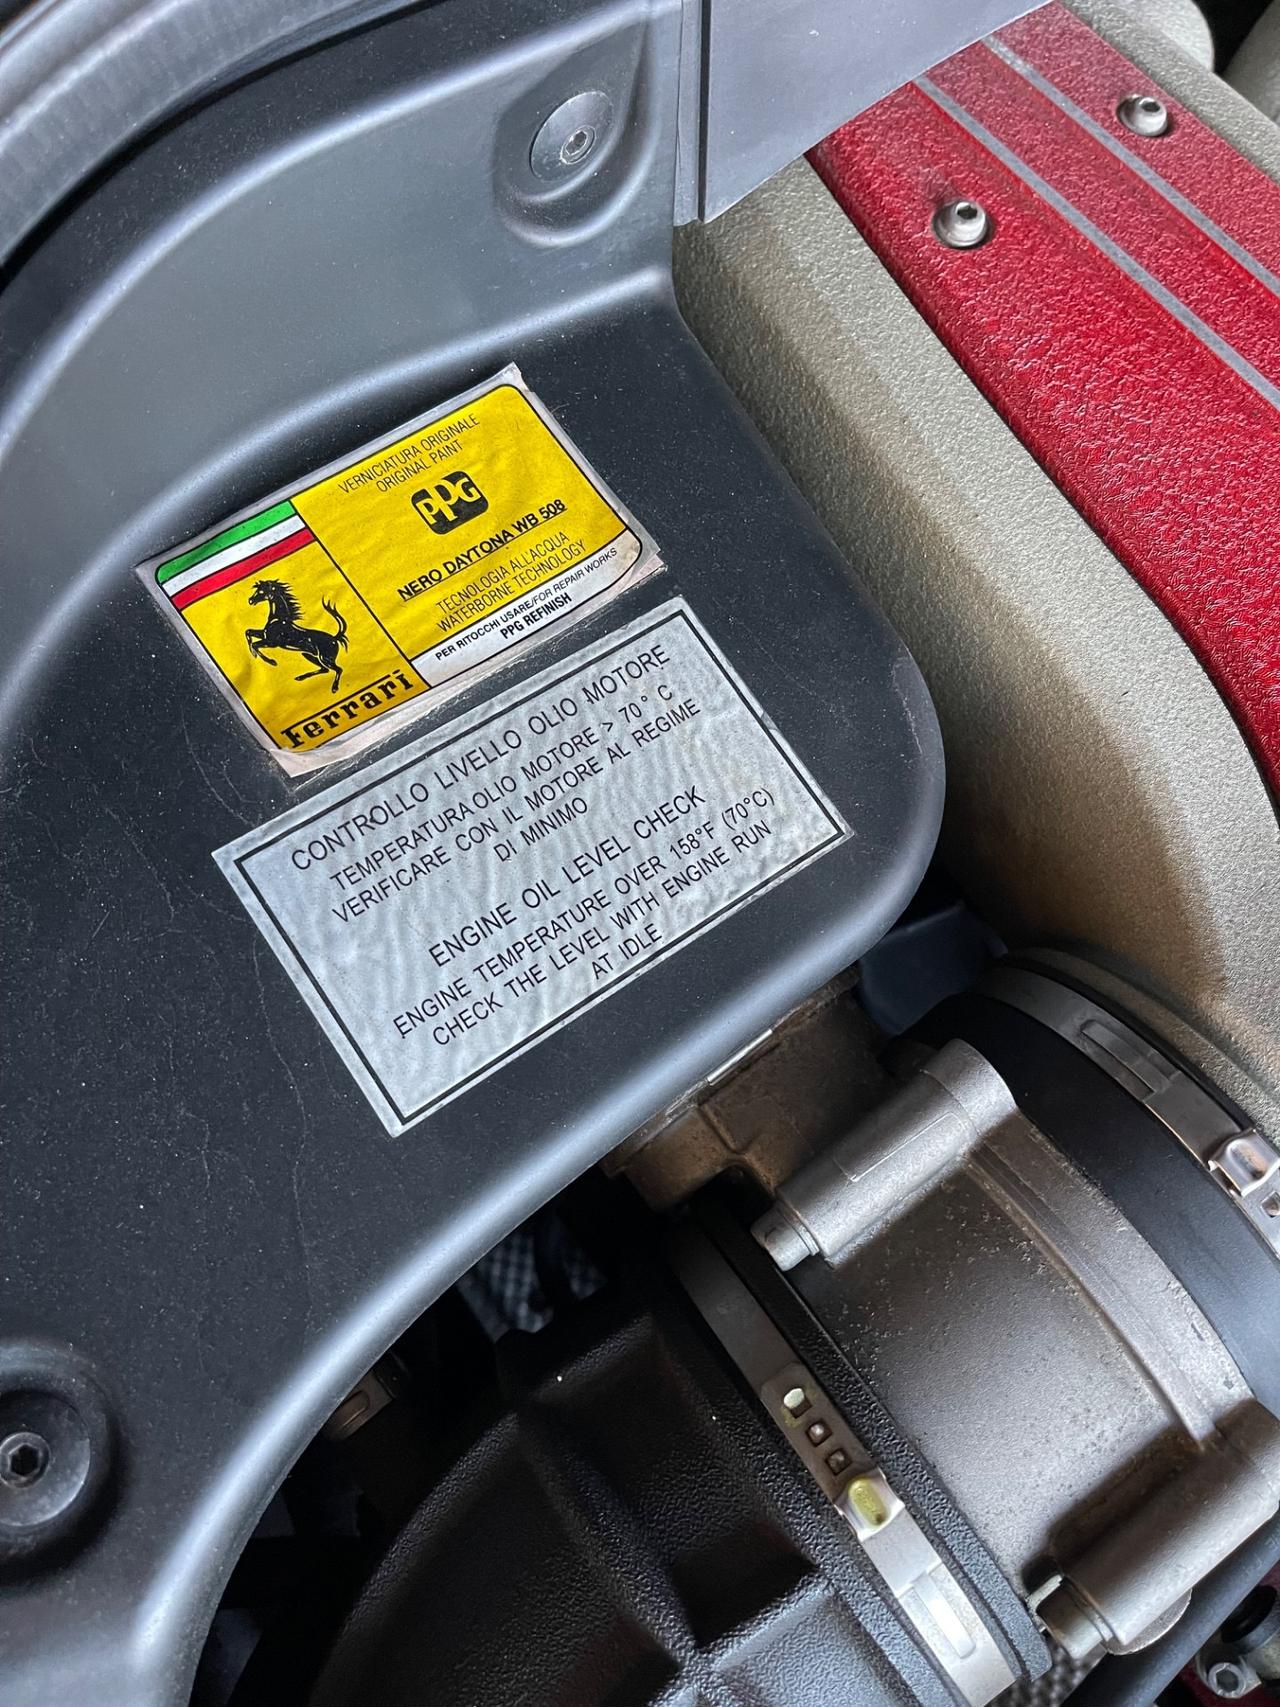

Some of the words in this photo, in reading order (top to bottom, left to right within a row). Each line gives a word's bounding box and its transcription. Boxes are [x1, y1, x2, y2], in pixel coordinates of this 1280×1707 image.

[338, 446, 422, 493] VERNICIATURA
[420, 414, 480, 451] ORIGINALE
[376, 458, 432, 492] ORIGINAL
[429, 439, 462, 464] PAINT
[414, 475, 483, 525] PPG
[397, 569, 442, 601] NERO
[443, 529, 513, 575] DAYTONA
[512, 513, 539, 538] WB
[540, 499, 566, 520] 508
[436, 566, 511, 614] TECNOLOGIA
[511, 532, 570, 572] ALL'ACQUA
[436, 580, 515, 632] WATERBORNE
[515, 540, 586, 587] TECHNOLOGY
[435, 645, 456, 660] PER
[456, 619, 500, 648] RITOCCHI
[553, 570, 584, 595] REPAIR
[584, 548, 617, 573] WORKS
[500, 620, 524, 639] PPG
[524, 592, 572, 626] REFINISH
[281, 670, 414, 748] Ferrari
[292, 782, 428, 870] CONTROLLO
[434, 730, 522, 790] LIVELLO
[528, 698, 578, 735] OLIO
[582, 644, 670, 704] MOTORE
[521, 727, 599, 782] MOTORE
[332, 846, 452, 922] VERIFICARE
[456, 818, 499, 852] CON
[502, 806, 524, 824] IL
[524, 757, 603, 812] MOTORE
[606, 742, 631, 764] AL
[630, 698, 700, 748] REGIME
[494, 839, 518, 862] DI
[520, 798, 587, 846] MINIMO
[393, 977, 472, 1038] ENGINE
[472, 889, 612, 982] TEMPERATURE
[614, 856, 667, 894] OVER
[670, 820, 714, 860] 158°F
[722, 788, 774, 830] (70°C)
[428, 902, 517, 967] ENGINE
[522, 880, 561, 908] OIL
[562, 836, 631, 884] LEVEL
[634, 785, 706, 839] CHECK
[433, 992, 504, 1045] CHECK
[504, 964, 547, 998] THE
[549, 927, 610, 970] LEVEL
[610, 892, 660, 930] WITH
[662, 846, 730, 898] ENGINE
[731, 820, 772, 853] RUN
[592, 952, 614, 980] AT
[618, 923, 662, 962] IDLE
